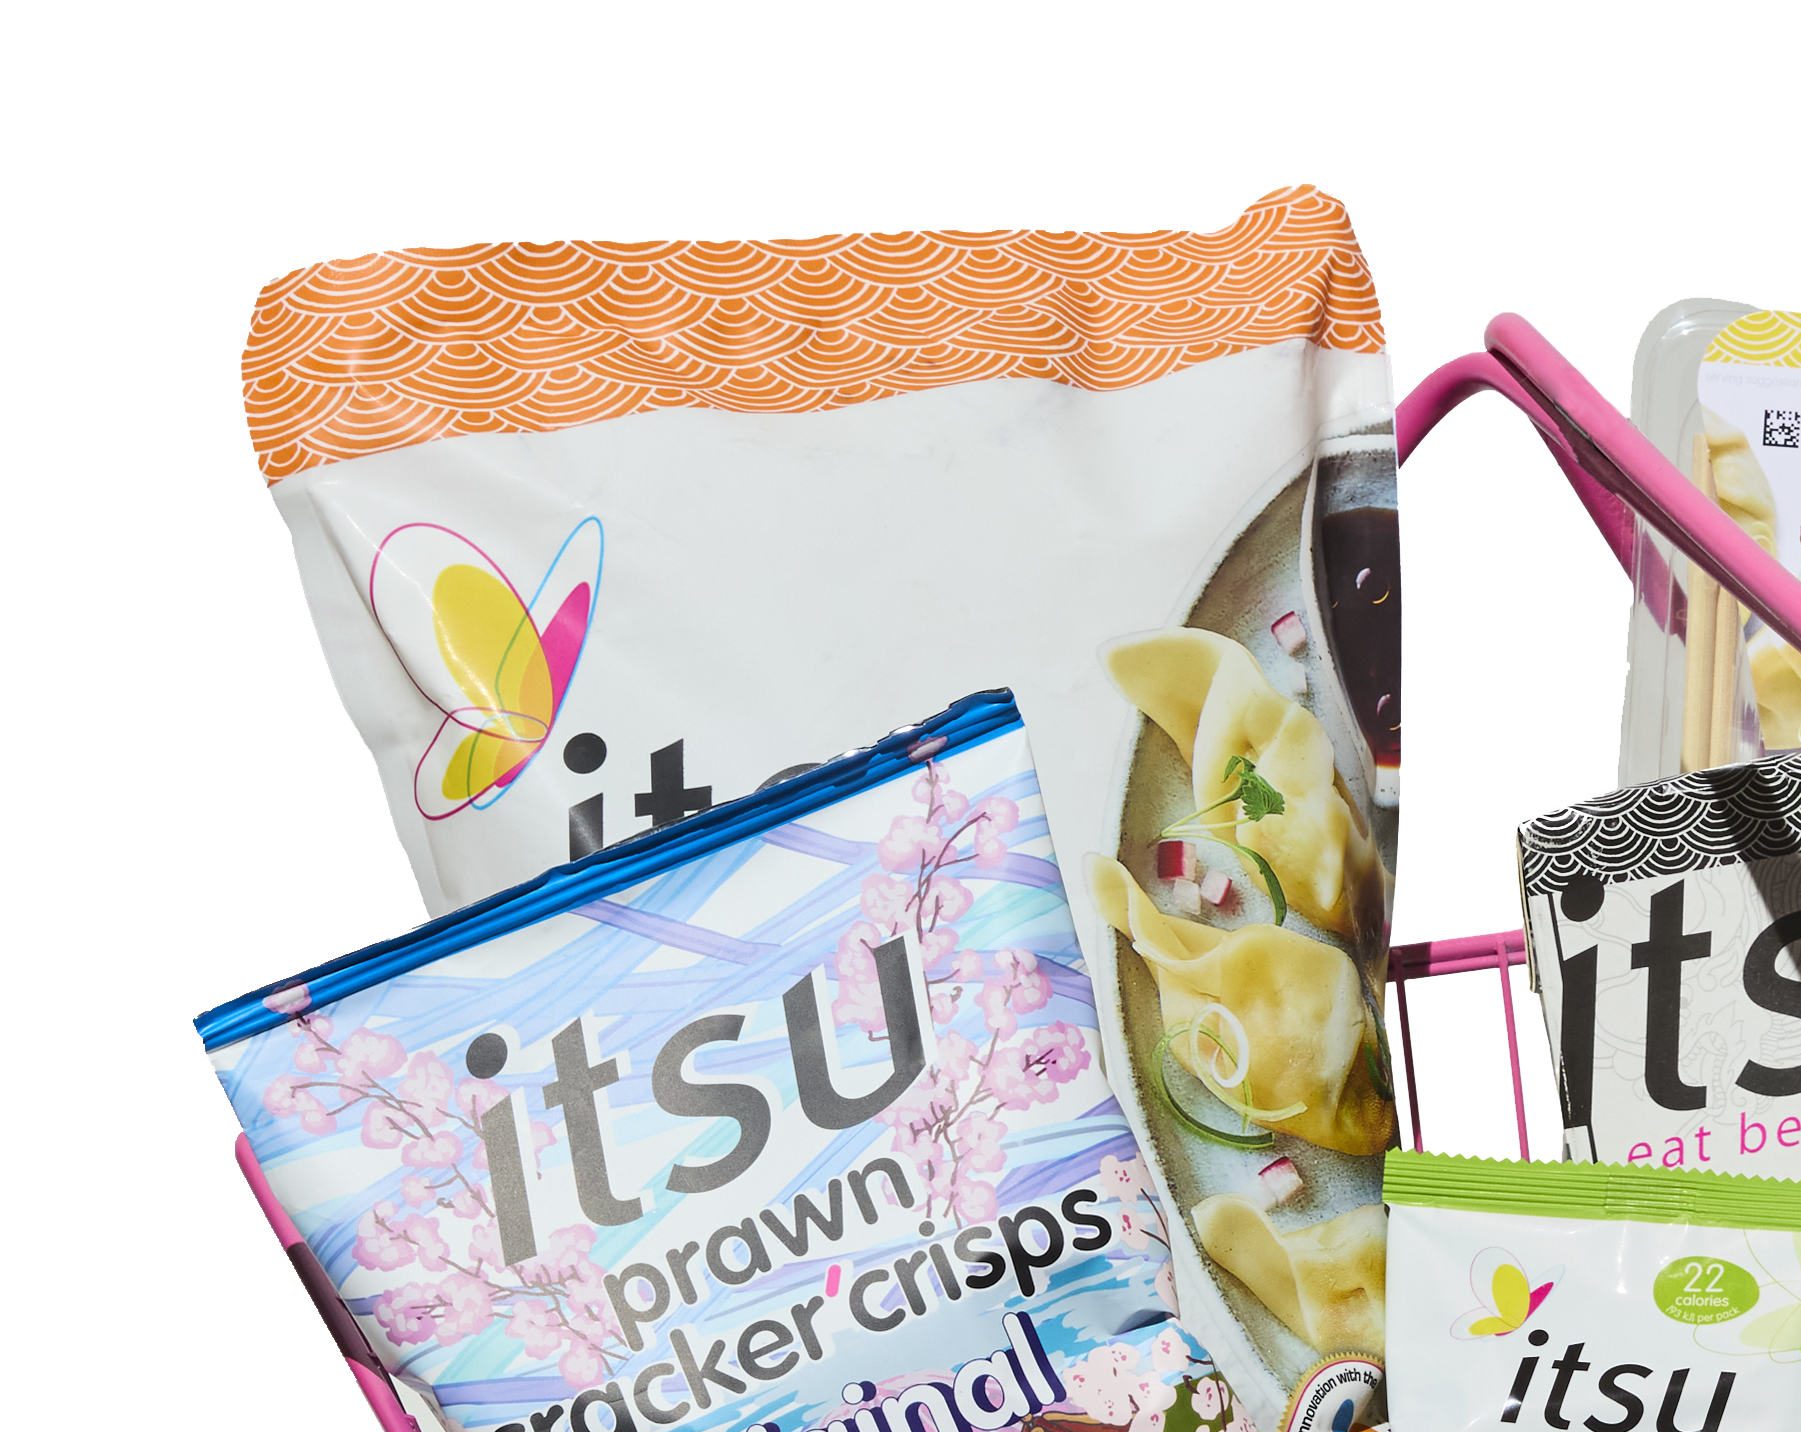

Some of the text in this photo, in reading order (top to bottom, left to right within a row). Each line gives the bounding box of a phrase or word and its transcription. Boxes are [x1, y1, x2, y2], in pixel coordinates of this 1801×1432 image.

[466, 936, 929, 1267] itsu
[1628, 1124, 1713, 1166] eat
[603, 1157, 915, 1350] prawn
[1683, 1262, 1725, 1292] 22
[1675, 1294, 1730, 1308] calories
[1697, 1306, 1741, 1324] per pack
[1336, 1368, 1361, 1385] with
[1363, 1371, 1379, 1389] the
